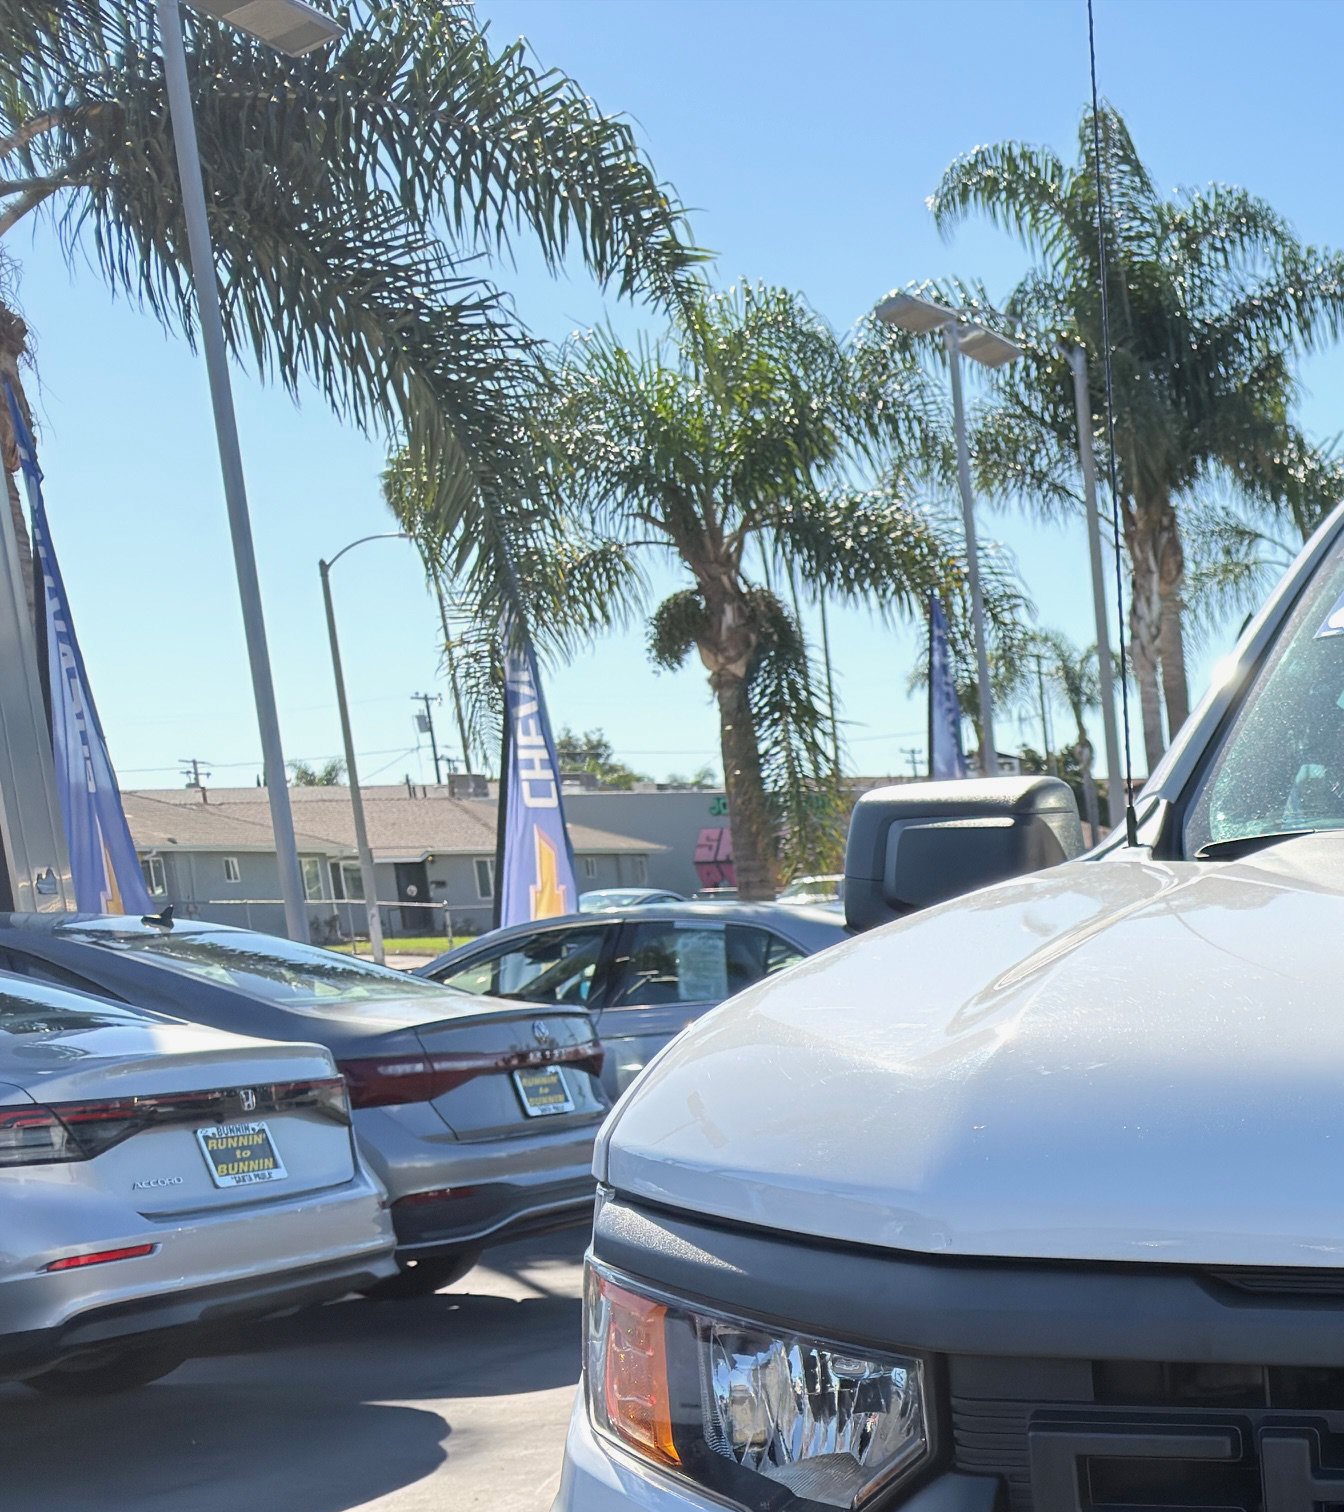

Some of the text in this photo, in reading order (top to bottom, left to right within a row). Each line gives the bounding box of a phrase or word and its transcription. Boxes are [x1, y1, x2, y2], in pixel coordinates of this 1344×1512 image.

[208, 1133, 266, 1150] RUNNIN'
[236, 1149, 251, 1158] to
[217, 1158, 273, 1175] BUNNIN
